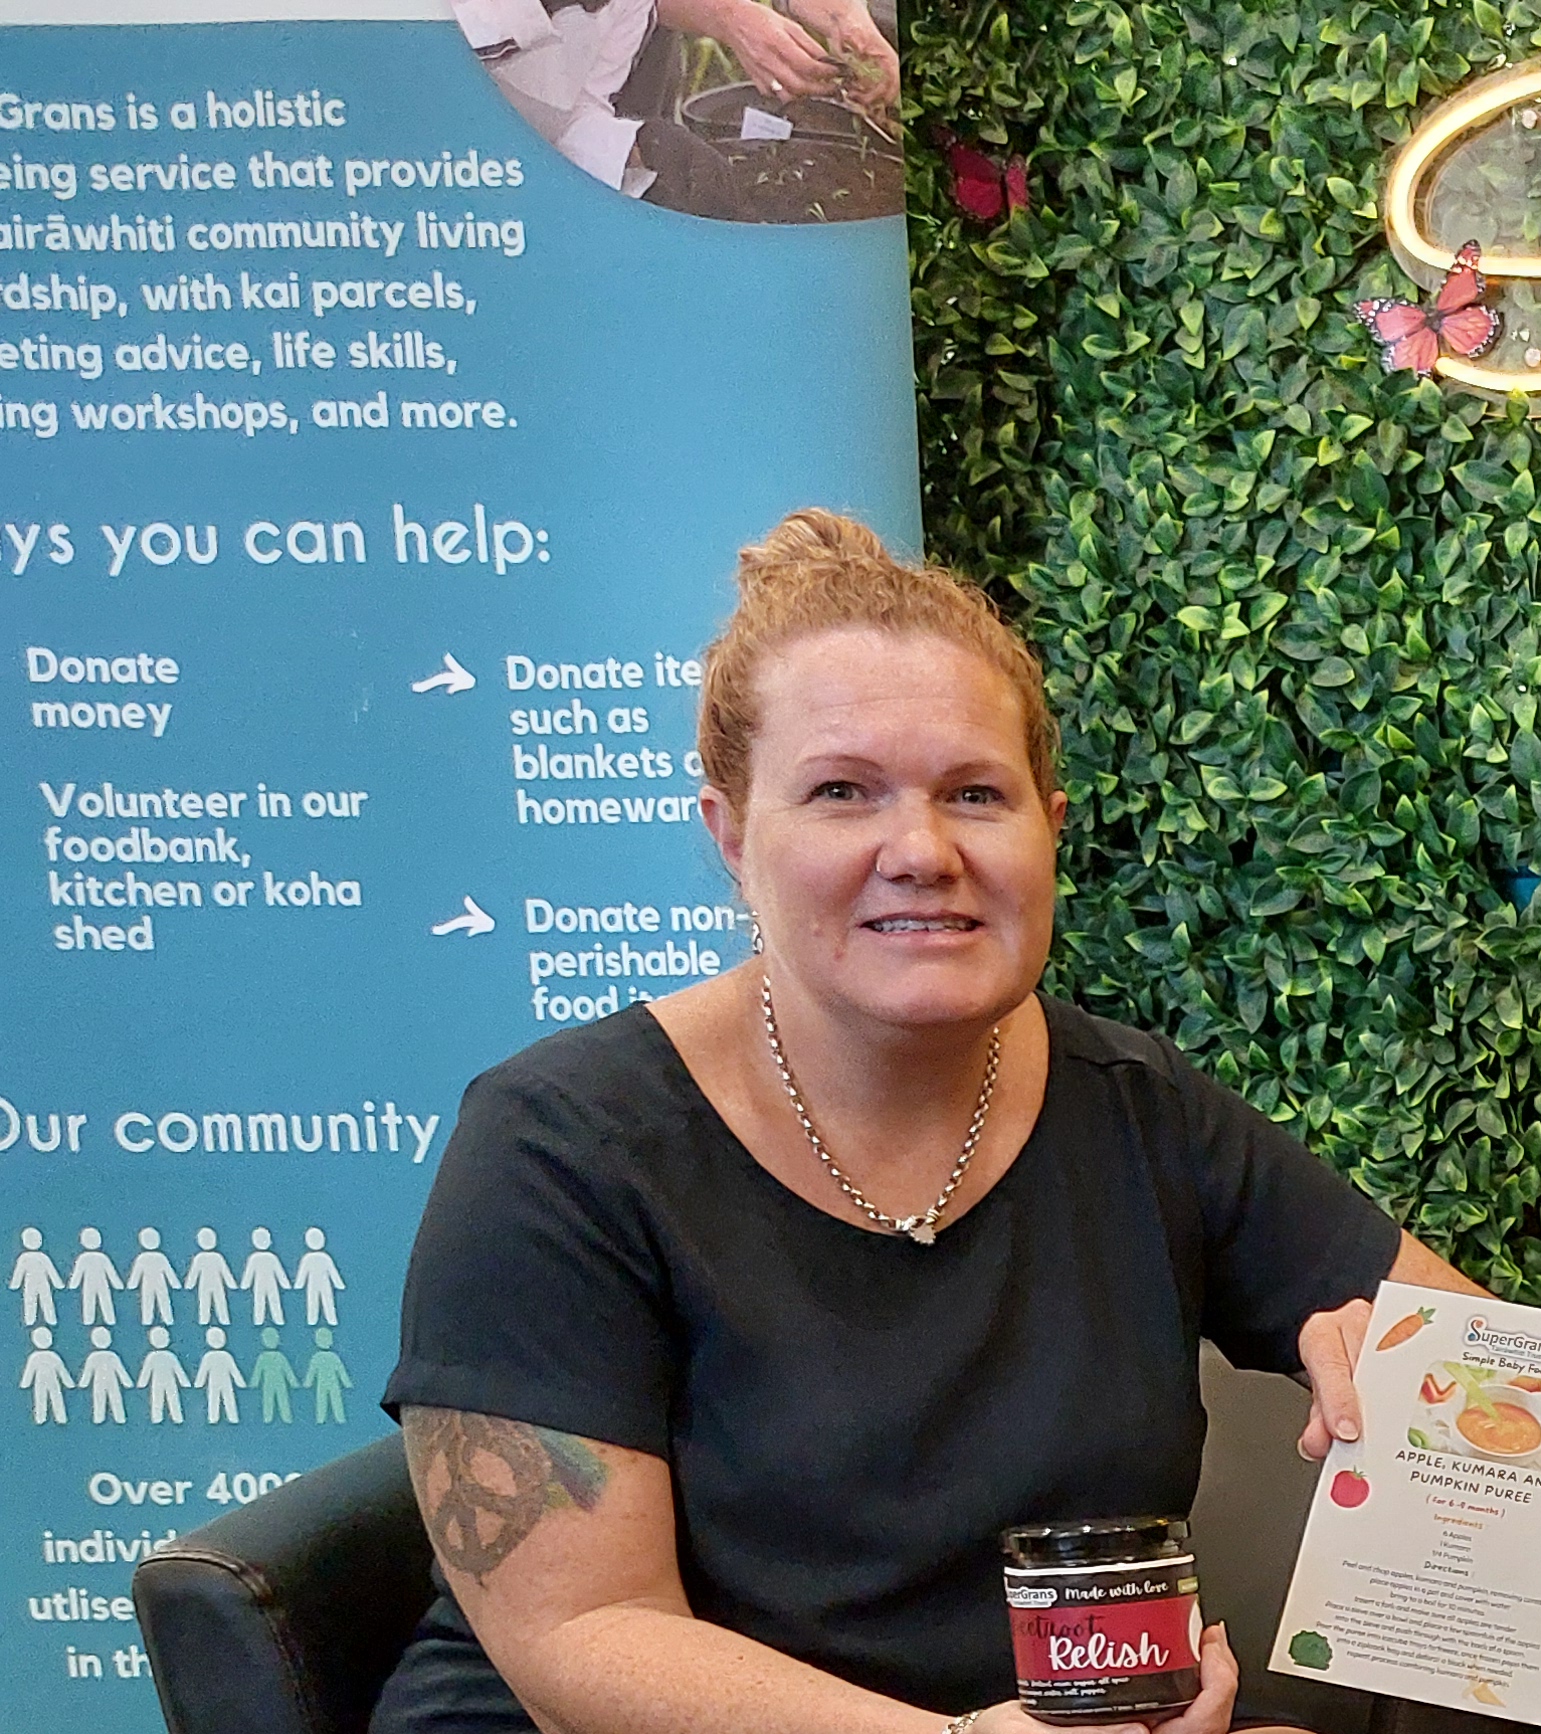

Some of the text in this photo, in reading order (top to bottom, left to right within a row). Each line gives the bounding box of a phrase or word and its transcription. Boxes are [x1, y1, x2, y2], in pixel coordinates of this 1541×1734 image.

[126, 92, 159, 130] is
[170, 99, 197, 131] a
[207, 90, 347, 129] holistic
[90, 153, 237, 192] service
[249, 151, 334, 189] that
[345, 150, 525, 198] provides
[187, 211, 526, 257] community living
[142, 271, 477, 317] with kai parcels,
[115, 333, 262, 376] advice,
[273, 330, 337, 371] life
[349, 330, 457, 376] skills,
[71, 393, 300, 438] workshops,
[312, 391, 389, 428] and
[401, 399, 518, 429] more.
[101, 521, 219, 577] you
[243, 519, 367, 565] can
[392, 503, 552, 577] help:
[26, 646, 181, 685] Donate
[505, 654, 645, 692] Donate
[32, 701, 173, 738] money
[510, 698, 650, 736] such as
[512, 742, 674, 781] blankets
[39, 782, 369, 819] Volunteer in our
[516, 788, 704, 826] homewar
[44, 826, 252, 869] foodbank,
[48, 870, 363, 908] kitchen or koha
[53, 915, 155, 952] shed
[525, 898, 752, 934] Donate non-
[529, 939, 722, 987] perishable
[532, 985, 619, 1023] food
[0, 1098, 441, 1164] Our community
[1462, 1351, 1495, 1367] Simple
[1498, 1357, 1526, 1374] Baby
[1395, 1450, 1446, 1470] APPLE,
[1451, 1460, 1518, 1483] KUMARA
[88, 1471, 304, 1506] Over 400
[1409, 1471, 1533, 1504] PUMPKIN PUREE
[1065, 1580, 1170, 1601] Made with love
[66, 1645, 102, 1678] in
[1048, 1632, 1170, 1672] Relish
